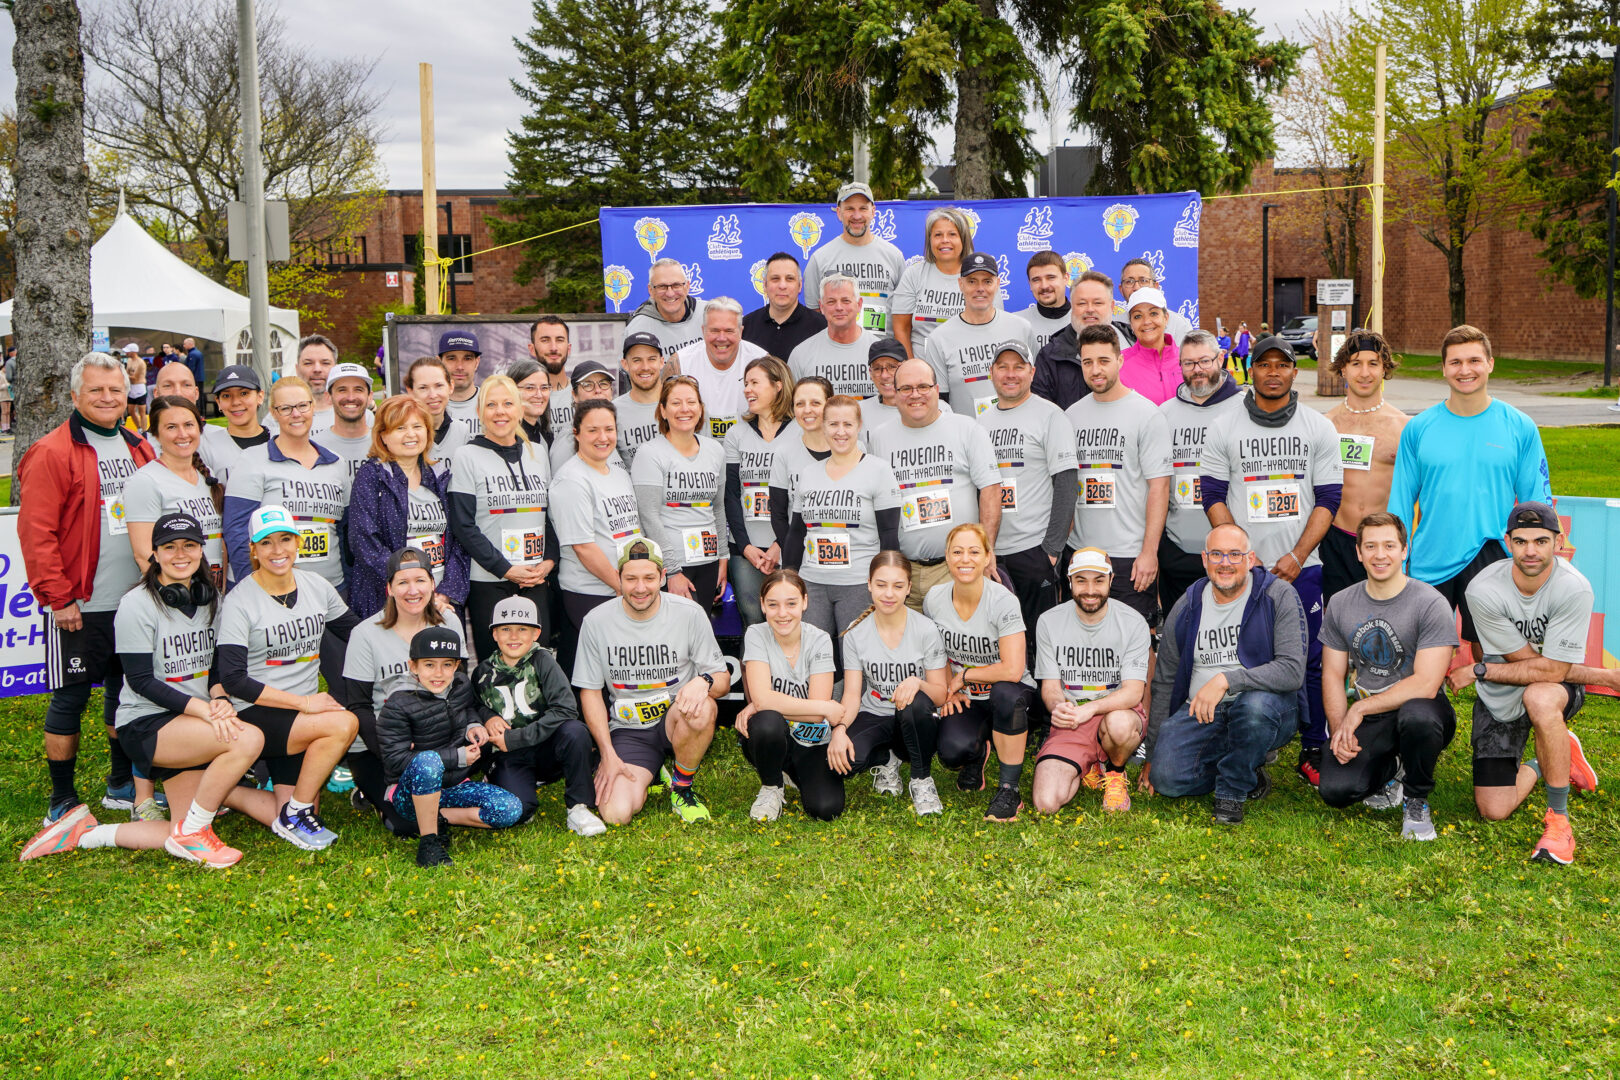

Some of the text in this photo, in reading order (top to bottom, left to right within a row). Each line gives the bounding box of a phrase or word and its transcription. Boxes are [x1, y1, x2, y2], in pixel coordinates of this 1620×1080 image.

[870, 313, 881, 326] 77
[891, 444, 945, 469] L'AVENIR
[1240, 436, 1301, 460] L'AVENIR
[1346, 444, 1362, 460] 22
[1241, 459, 1307, 474] SAINT-HYACINTHE
[485, 474, 544, 495] L'AVENIR
[667, 471, 717, 489] L'AVENIR
[281, 479, 343, 503] L'AVENIR
[1086, 484, 1113, 499] 5265
[919, 499, 949, 519] 5229
[1268, 494, 1298, 512] 5297
[304, 535, 326, 552] 485
[818, 544, 848, 560] 5341
[511, 610, 530, 619] FOX
[265, 613, 326, 648] L'AVENIR
[1352, 621, 1375, 649] Reebok
[162, 627, 215, 659] L'AVENIR
[440, 641, 457, 650] FOX
[607, 643, 670, 667] L'AVENIR
[1056, 645, 1114, 668] L'AVENIR
[610, 665, 679, 680] SAINT-HYACINTHE
[640, 703, 668, 720] 503
[793, 725, 825, 740] 2074
